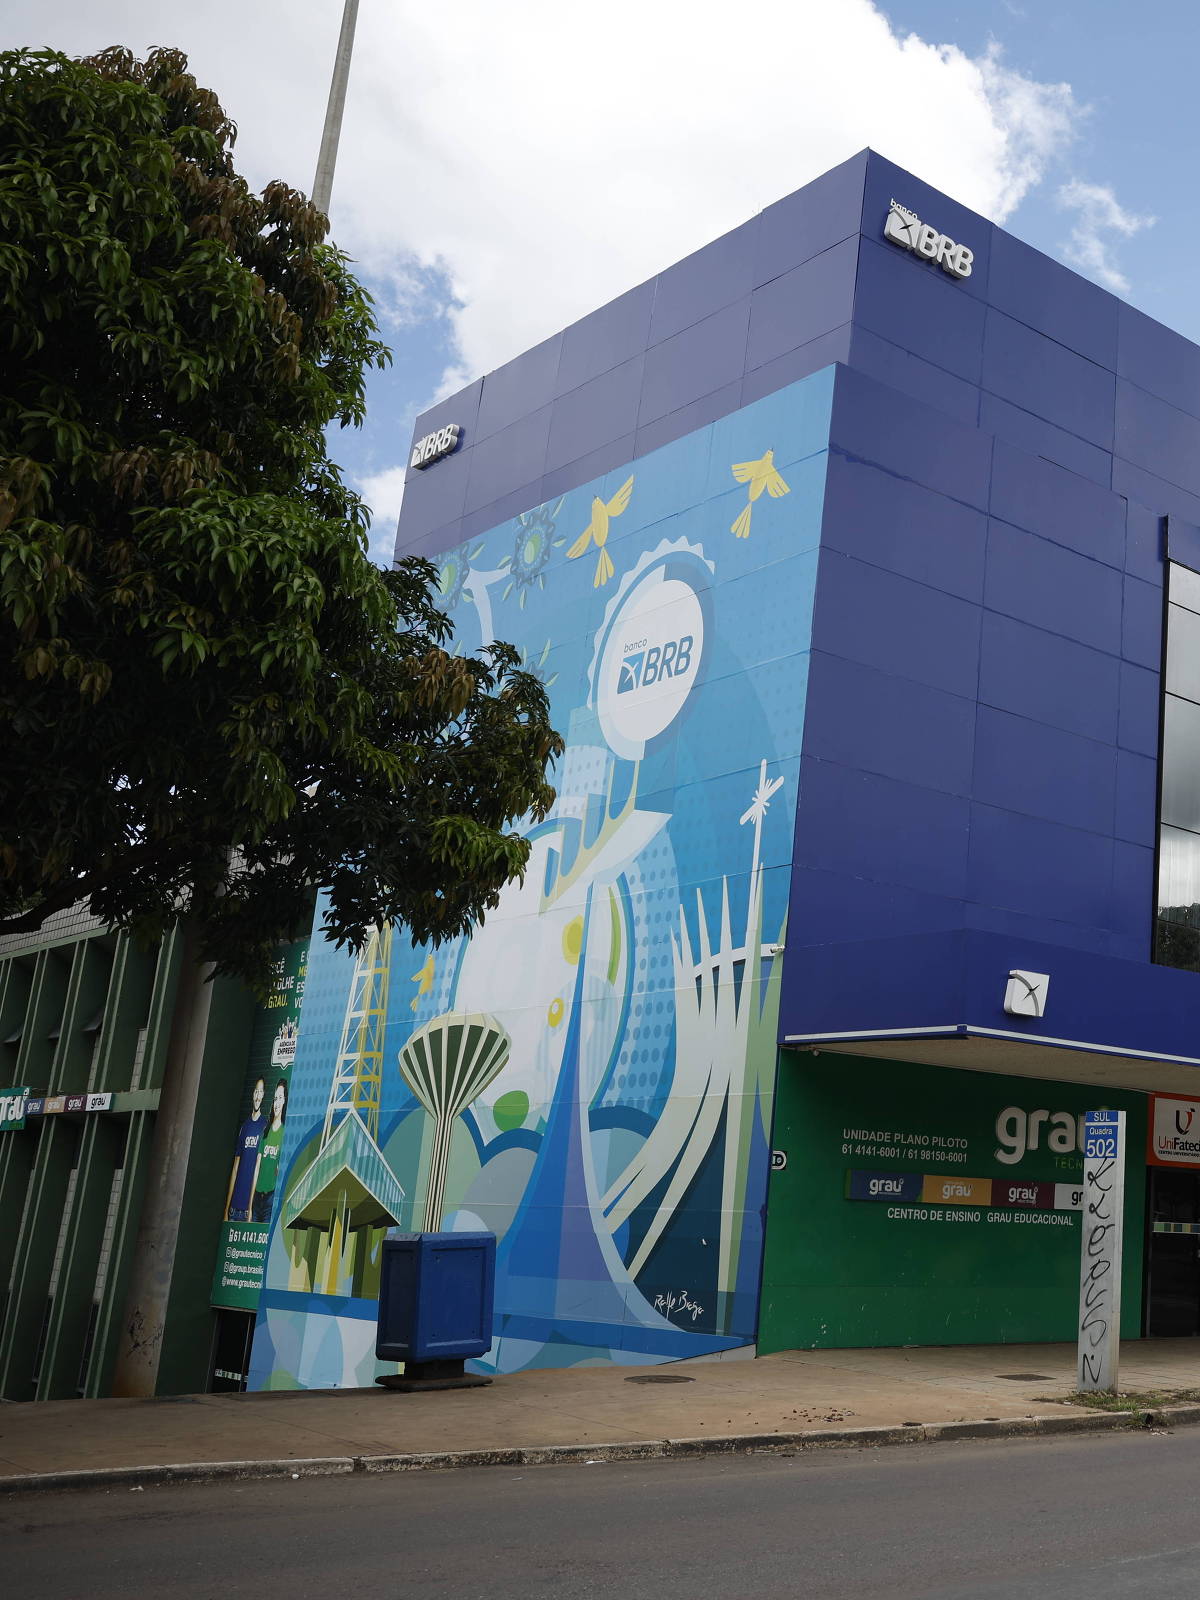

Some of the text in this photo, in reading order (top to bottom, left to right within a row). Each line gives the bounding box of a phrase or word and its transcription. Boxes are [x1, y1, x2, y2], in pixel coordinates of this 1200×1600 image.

[890, 198, 918, 219] banco
[916, 223, 974, 278] BRB
[424, 424, 460, 461] BRB
[623, 638, 648, 653] banco
[642, 635, 694, 687] BRB
[1093, 1112, 1110, 1122] SUL
[843, 1128, 969, 1149] UNIDADE PLANO PILOTO
[1089, 1127, 1113, 1135] Quadra
[842, 1143, 852, 1155] 61
[855, 1145, 900, 1158] 4141-6001
[908, 1149, 918, 1160] 61
[920, 1149, 967, 1163] 98150-6001
[1086, 1138, 1115, 1158] 502
[887, 1207, 1073, 1226] CENTRO DE ENSINO GRAU EDUCACIONAL
